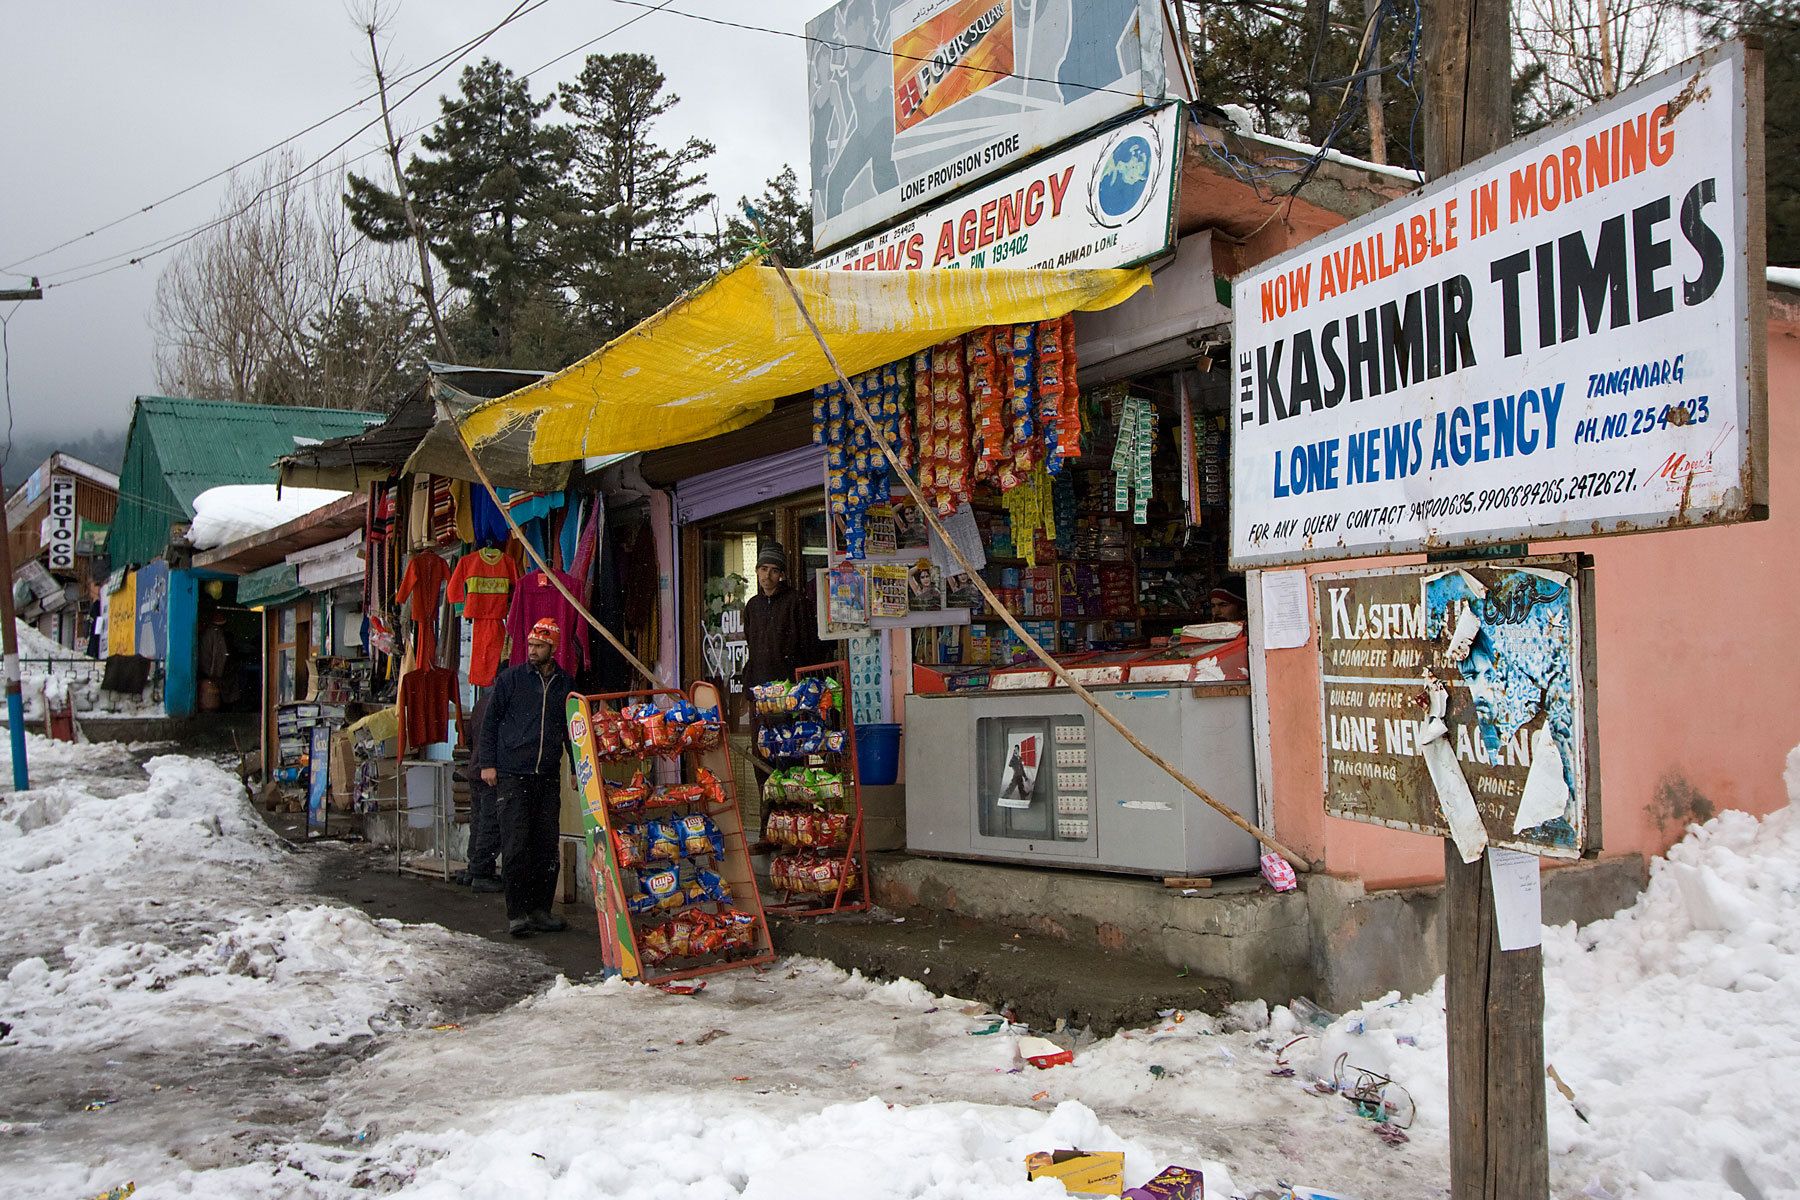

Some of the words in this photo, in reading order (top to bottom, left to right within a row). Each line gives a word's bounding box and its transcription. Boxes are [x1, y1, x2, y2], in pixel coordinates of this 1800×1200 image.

[918, 33, 970, 93] FOUR
[900, 177, 926, 203] LONE
[927, 151, 982, 194] PROVISION
[984, 133, 1020, 167] STORE
[933, 164, 1076, 267] AGENCY
[1260, 263, 1311, 323] NOW
[1319, 197, 1459, 301] AVAILABLE
[1470, 180, 1499, 241] IN
[1509, 103, 1676, 224] MORNING
[845, 246, 860, 261] PHONE
[864, 239, 875, 252] AND
[879, 233, 889, 246] FAX
[970, 250, 986, 269] PIN
[992, 233, 1029, 265] 193402
[1056, 244, 1093, 269] AHMAD
[1094, 233, 1118, 254] LONE
[1240, 350, 1253, 430] THE
[1257, 273, 1477, 426] KASHMIR
[1490, 176, 1725, 358] TIMES
[1587, 354, 1684, 398] TANGMARG
[1274, 438, 1340, 498] LONE
[1346, 418, 1422, 486] NEWS
[1430, 383, 1565, 471] AGENCY
[1248, 523, 1270, 542] FOR
[1273, 519, 1299, 539] ANY
[1303, 513, 1341, 538] QUERY
[1346, 504, 1406, 529] CONTACT
[721, 610, 745, 634] GUL
[1339, 648, 1387, 668] COMPLETE
[1392, 649, 1422, 669] DAILY
[730, 680, 743, 694] Hair
[1330, 690, 1363, 707] BUREAU
[1368, 691, 1402, 709] OFFICE
[1330, 714, 1379, 754] LONE
[1384, 718, 1424, 757] NEW
[1333, 759, 1397, 781] TANGMARG
